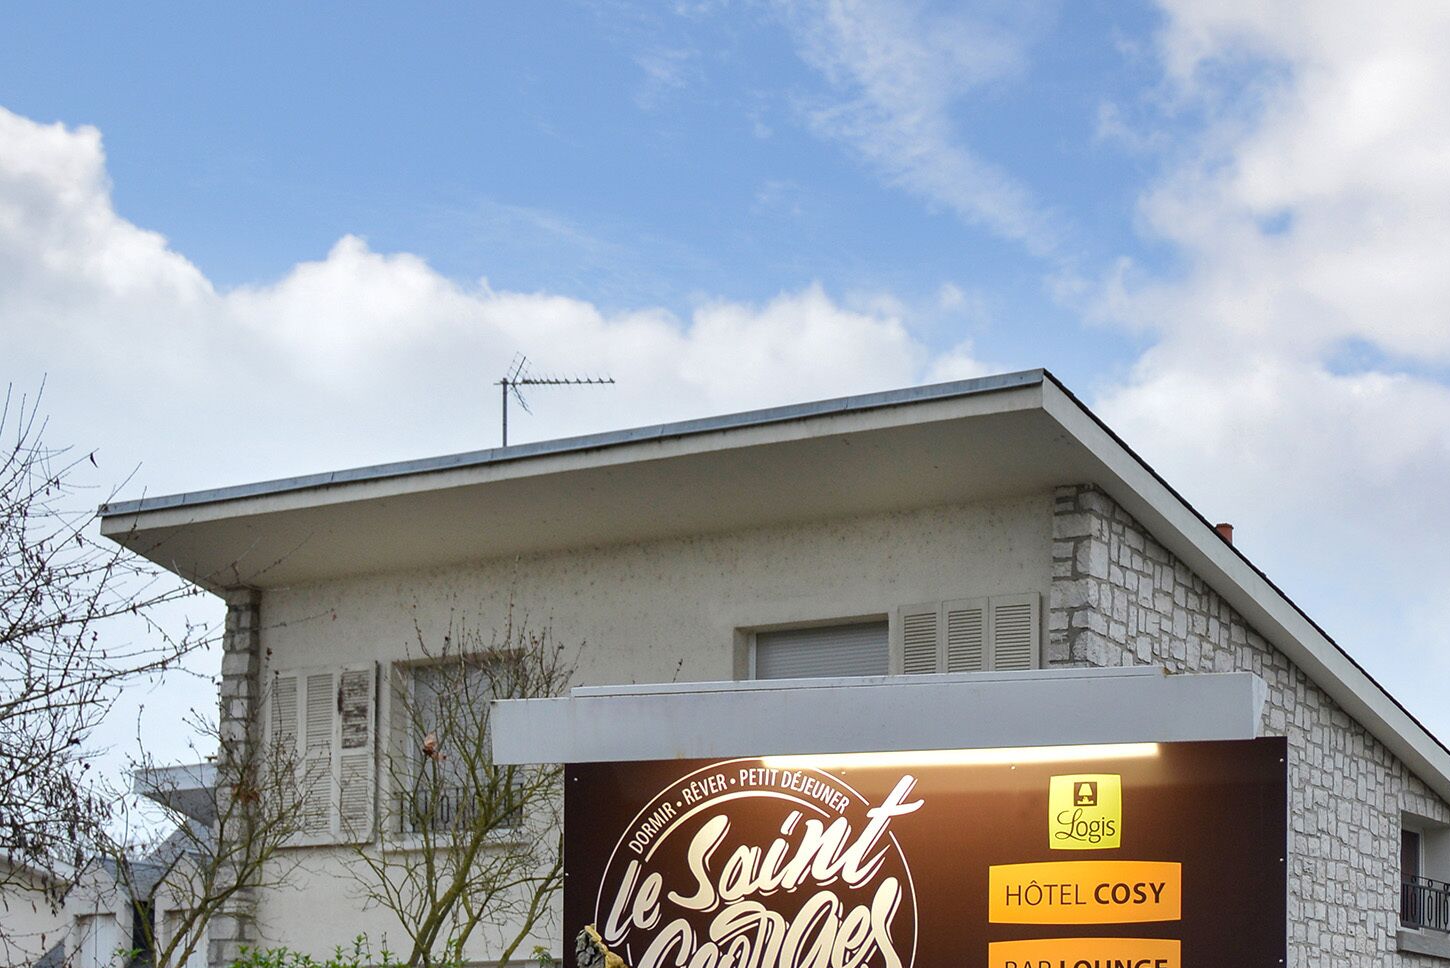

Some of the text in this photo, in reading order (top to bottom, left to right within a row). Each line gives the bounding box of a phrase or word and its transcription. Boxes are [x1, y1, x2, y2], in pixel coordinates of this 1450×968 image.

[628, 768, 850, 855] DORMIR RÊVER PETIT DÉJEUNER
[1054, 808, 1116, 844] Logis
[667, 775, 925, 912] Saint
[1005, 879, 1166, 906] HÔTEL COSY
